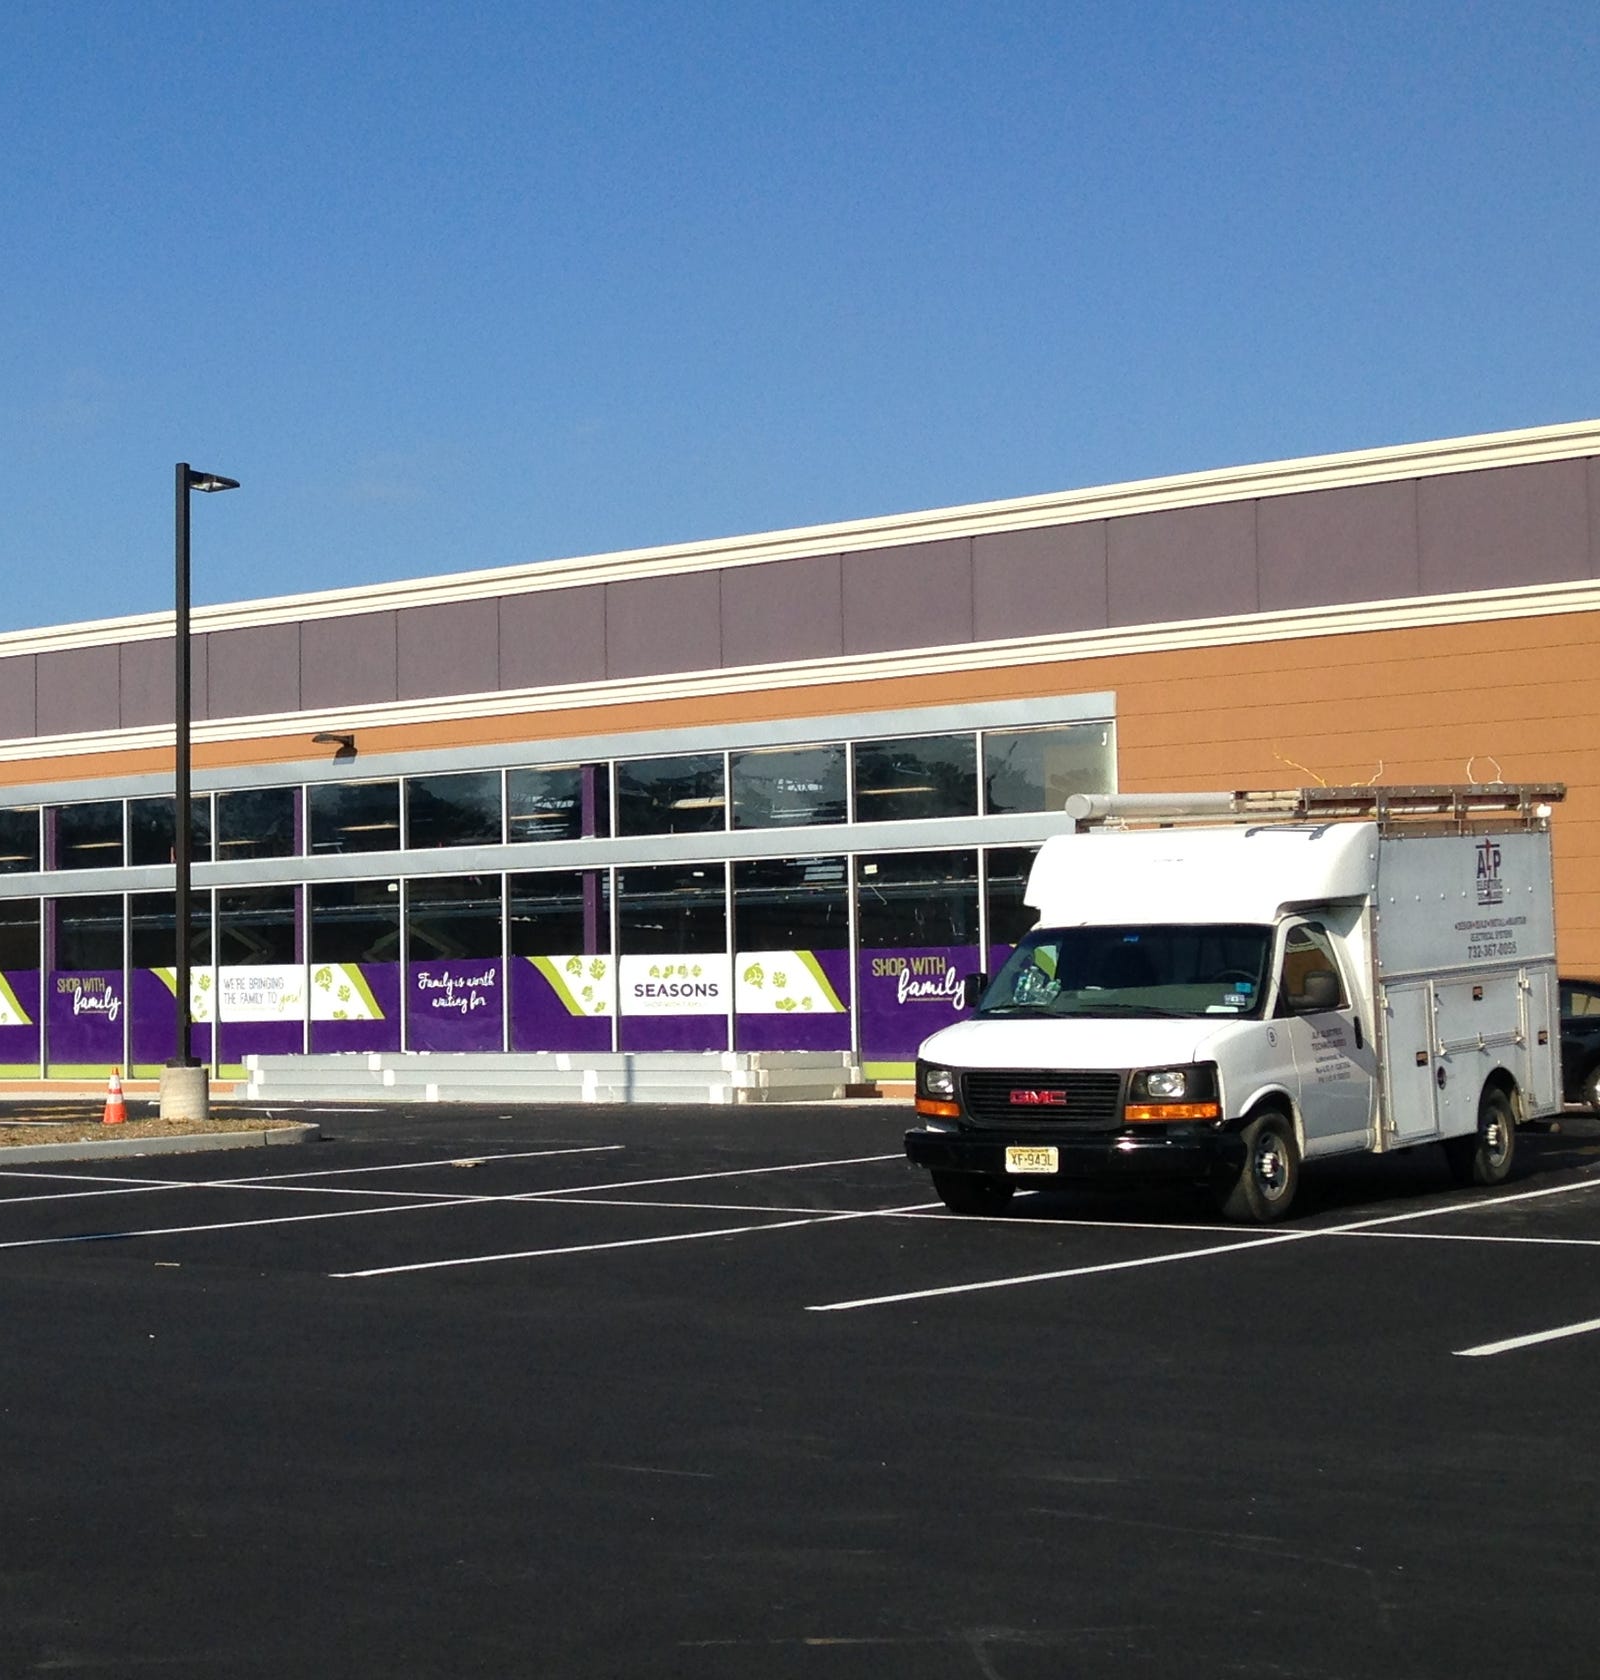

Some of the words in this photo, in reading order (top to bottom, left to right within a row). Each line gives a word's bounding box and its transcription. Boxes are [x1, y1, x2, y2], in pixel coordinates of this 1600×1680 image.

[872, 957, 907, 977] SHOP
[910, 956, 946, 976] WITH
[56, 978, 81, 993] SHOP
[82, 977, 106, 993] WITH
[223, 977, 246, 990] WE'RE
[249, 976, 284, 990] BRINGING
[418, 971, 453, 995] Family
[466, 968, 495, 987] worth
[634, 983, 719, 997] SEASONS
[897, 966, 966, 1010] family
[73, 985, 122, 1021] family
[223, 992, 237, 1004] THE
[240, 992, 264, 1004] FAMILY
[267, 991, 278, 1004] TO
[432, 995, 468, 1014] waiting
[470, 990, 487, 1010] for
[1009, 1090, 1067, 1106] GMC
